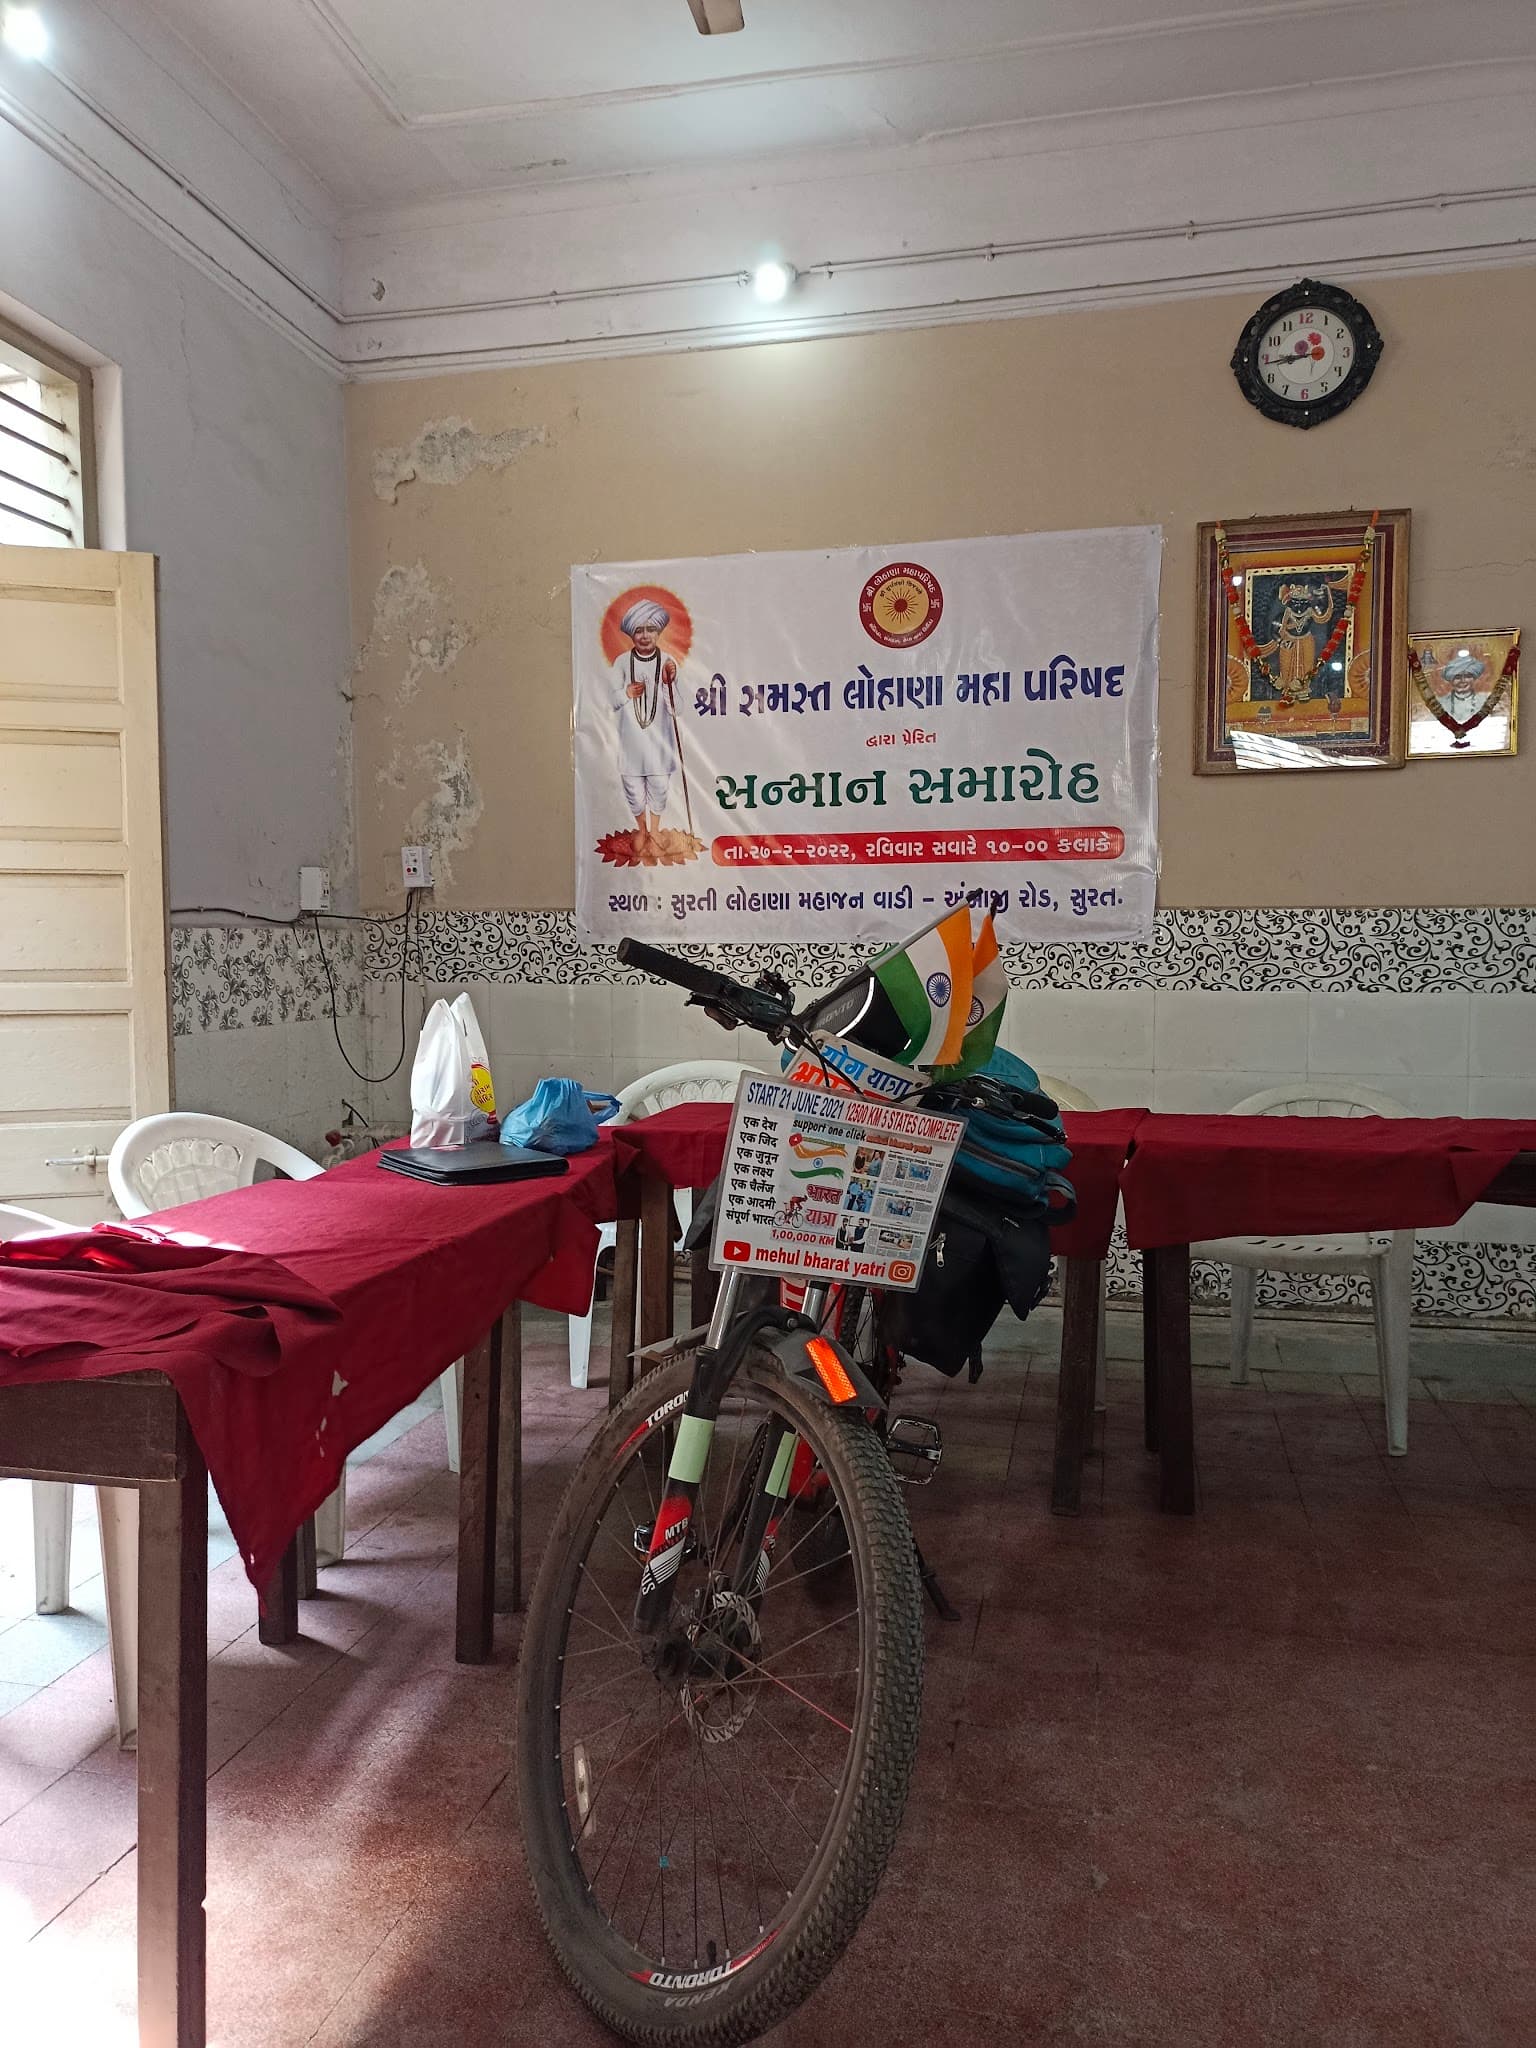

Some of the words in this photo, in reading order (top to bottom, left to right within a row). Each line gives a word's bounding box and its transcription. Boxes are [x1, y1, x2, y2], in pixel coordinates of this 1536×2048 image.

[1283, 321, 1293, 331] 11
[1299, 312, 1314, 324] 12
[1269, 336, 1281, 346] 10
[1337, 328, 1344, 339] 2
[1343, 347, 1350, 358] 3
[1268, 373, 1275, 383] 8
[1334, 366, 1342, 376] 4
[1282, 385, 1290, 395] 7
[1301, 389, 1308, 400] 6
[1321, 382, 1328, 392] 5
[694, 673, 726, 716] શ્રી
[739, 681, 831, 717] સમસ્ત
[843, 664, 943, 709] લોહાણા
[956, 672, 1010, 706] મહા
[1024, 654, 1125, 701] પરિષદ
[866, 734, 895, 747] દ્વારા
[902, 729, 936, 746] પ્રેરિત
[715, 771, 887, 809] સન્માન
[909, 748, 1099, 804] સમારોહ
[866, 836, 924, 857] રવિવાર
[932, 835, 976, 856] સવારે
[986, 840, 1048, 855] ૧૦-૦૦
[1057, 831, 1111, 853] કલાકે
[608, 894, 648, 912] સ્થળ
[671, 887, 717, 920] સુરતી
[726, 885, 790, 912] લોહાણા
[799, 891, 864, 911] મહાજન
[873, 884, 913, 909] વાડી
[1019, 881, 1059, 912] રોડ,
[1070, 887, 1123, 916] સુરત.
[747, 1081, 780, 1109] START
[778, 1089, 791, 1111] 21
[791, 1092, 822, 1116] JUNE
[820, 1098, 845, 1120] 2021
[844, 1102, 869, 1125] 12500
[867, 1105, 881, 1127] KM
[880, 1108, 888, 1128] 5
[887, 1109, 919, 1134] STATES
[917, 1116, 961, 1142] COMPLETE
[743, 1116, 760, 1128] एक
[761, 1116, 778, 1131] देश
[792, 1119, 827, 1134] support
[827, 1125, 843, 1137] one
[847, 1126, 866, 1142] click
[740, 1131, 757, 1144] एक
[758, 1132, 778, 1147] जिद
[737, 1147, 753, 1159] एक
[755, 1150, 779, 1165] जुनून
[734, 1162, 750, 1175] एक
[752, 1165, 774, 1178] लक्ष्य
[731, 1178, 747, 1190] एक
[728, 1194, 745, 1206] एक
[747, 1196, 776, 1210] आदमी
[807, 1183, 843, 1204] भारत
[726, 1207, 750, 1224] संपूर्ण
[752, 1213, 775, 1226] भारत
[805, 1208, 838, 1227] यात्रा
[771, 1229, 817, 1242] 1,00,000
[819, 1235, 835, 1246] KM
[756, 1247, 799, 1265] mehul
[803, 1251, 850, 1272] bharat
[852, 1261, 886, 1277] yatri
[664, 1517, 689, 1541] MTB
[648, 1960, 732, 1990] TORONTO
[663, 1978, 733, 2008] KENDA
